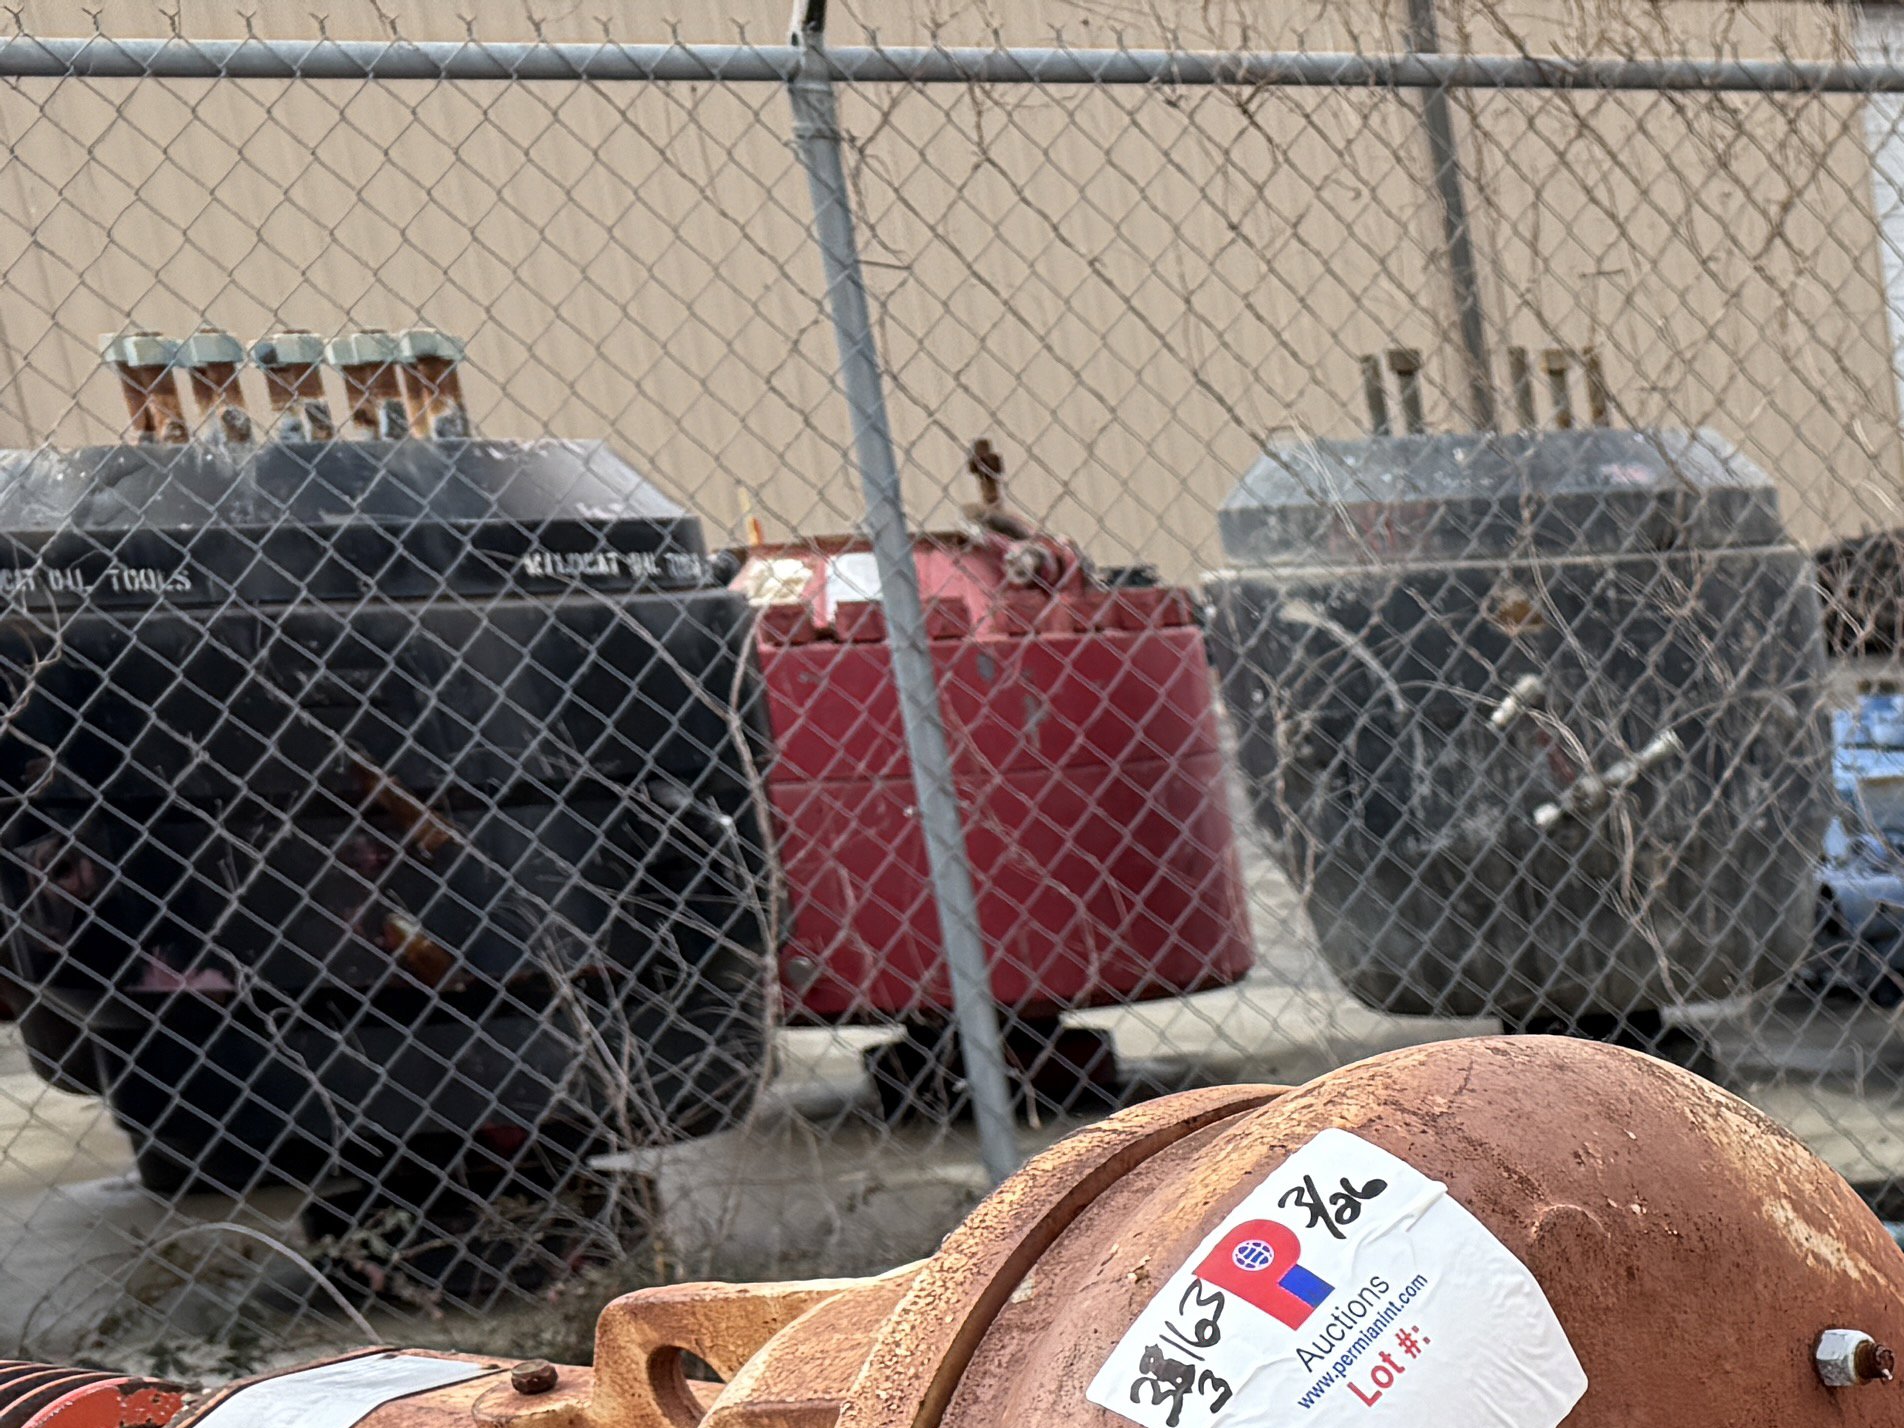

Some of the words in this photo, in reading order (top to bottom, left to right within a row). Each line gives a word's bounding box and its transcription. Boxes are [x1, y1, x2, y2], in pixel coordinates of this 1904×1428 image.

[106, 567, 192, 593] TOOLS
[1296, 1275, 1390, 1373] Auctions
[1297, 1272, 1429, 1410] www.permianint.com
[1346, 1351, 1406, 1408] Lot
[1394, 1325, 1431, 1359] #:
